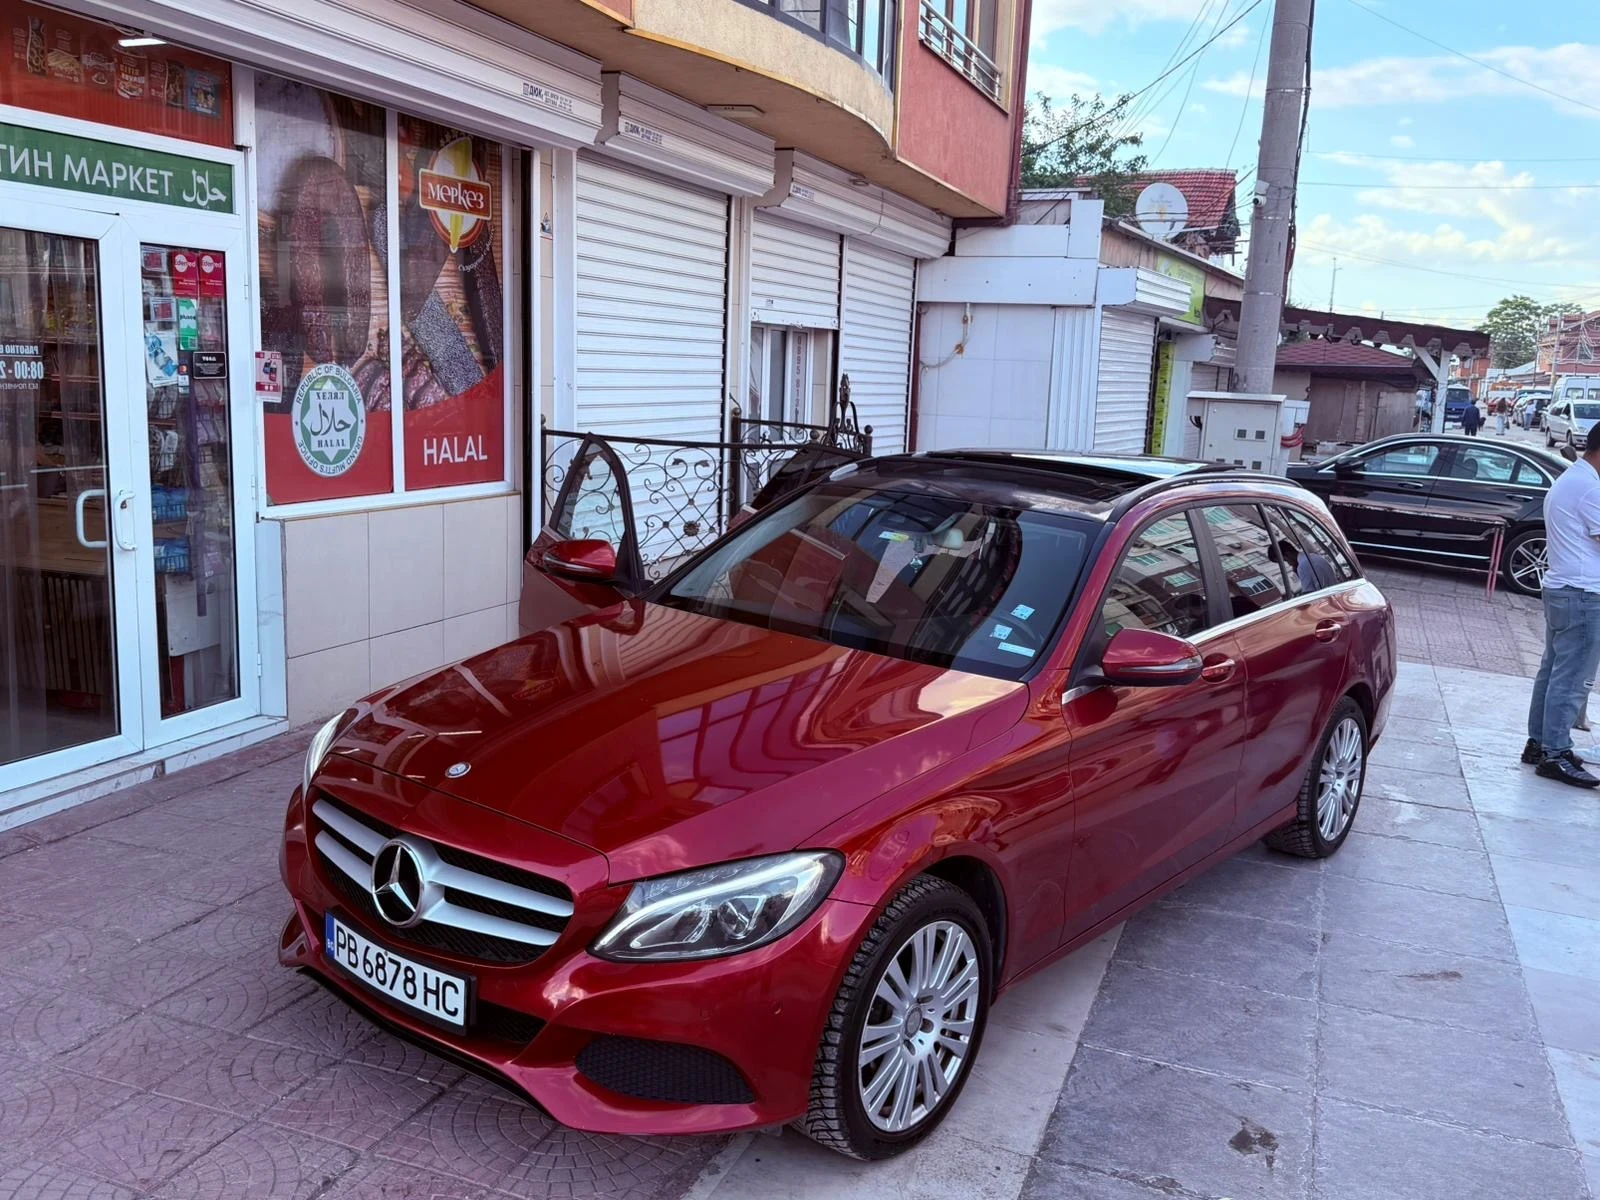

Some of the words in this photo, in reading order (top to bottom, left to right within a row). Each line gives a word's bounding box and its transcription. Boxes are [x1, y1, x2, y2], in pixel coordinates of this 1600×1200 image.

[63, 154, 173, 196] МАРКЕТ
[182, 168, 227, 206] حلال
[295, 366, 323, 405] REPUBLIC
[324, 365, 333, 374] OF
[335, 367, 362, 405] BULGARIA
[310, 402, 351, 436] حلال
[297, 439, 319, 469] OFFICE
[317, 438, 346, 448] HALAL
[346, 435, 364, 466] GRAND
[424, 434, 488, 466] HALAL
[336, 925, 358, 968] PB
[363, 945, 417, 1000] 6878
[423, 972, 459, 1017] HC
